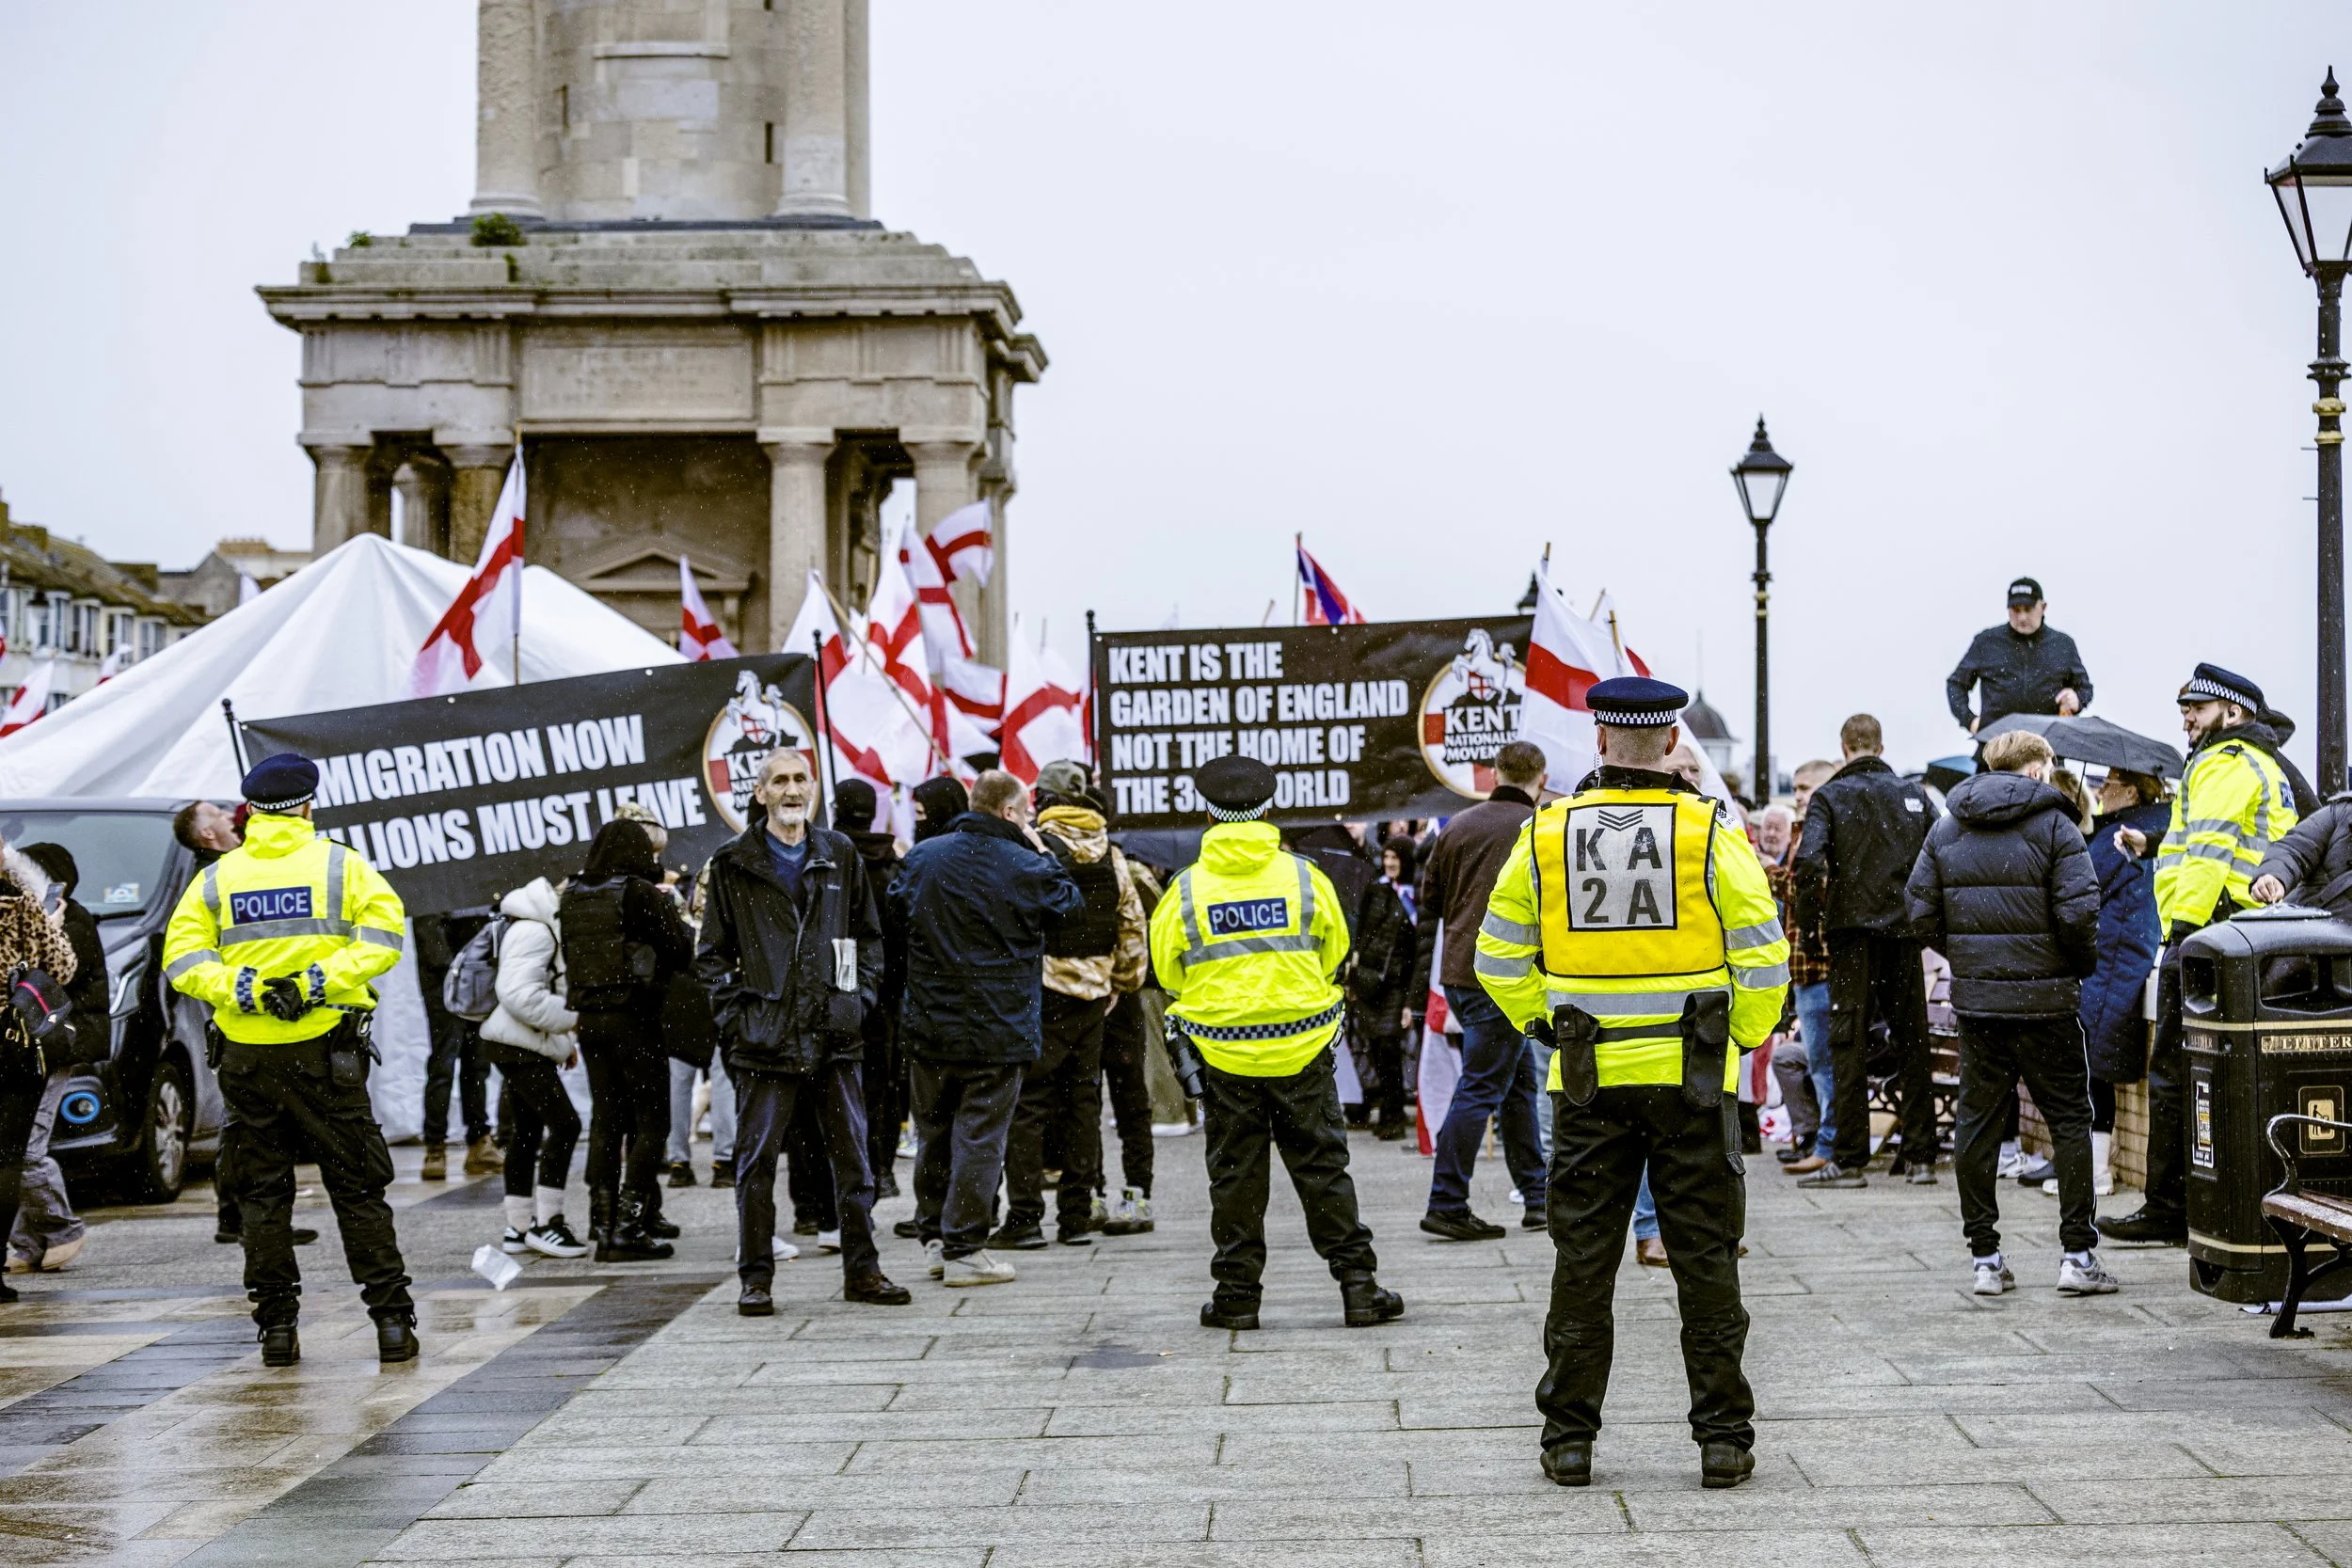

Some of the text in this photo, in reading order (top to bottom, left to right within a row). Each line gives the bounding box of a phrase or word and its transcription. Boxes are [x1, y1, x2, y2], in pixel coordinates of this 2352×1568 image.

[1107, 641, 1284, 685] KENT IS THE
[1109, 678, 1409, 728] GARDEN OF ENGLAND
[1445, 704, 1520, 734] KENT
[311, 713, 646, 810] MIGRATION NOW
[1110, 724, 1366, 771] NOT THE HOME OF
[1110, 776, 1171, 815] THE
[1266, 768, 1351, 810] ORLD
[475, 790, 593, 856] MUST
[1576, 827, 1663, 872] K A
[232, 891, 310, 920] POLICE
[1211, 902, 1285, 931] POLICE
[1581, 877, 1662, 926] 2 A
[2281, 1035, 2352, 1051] LITTER
